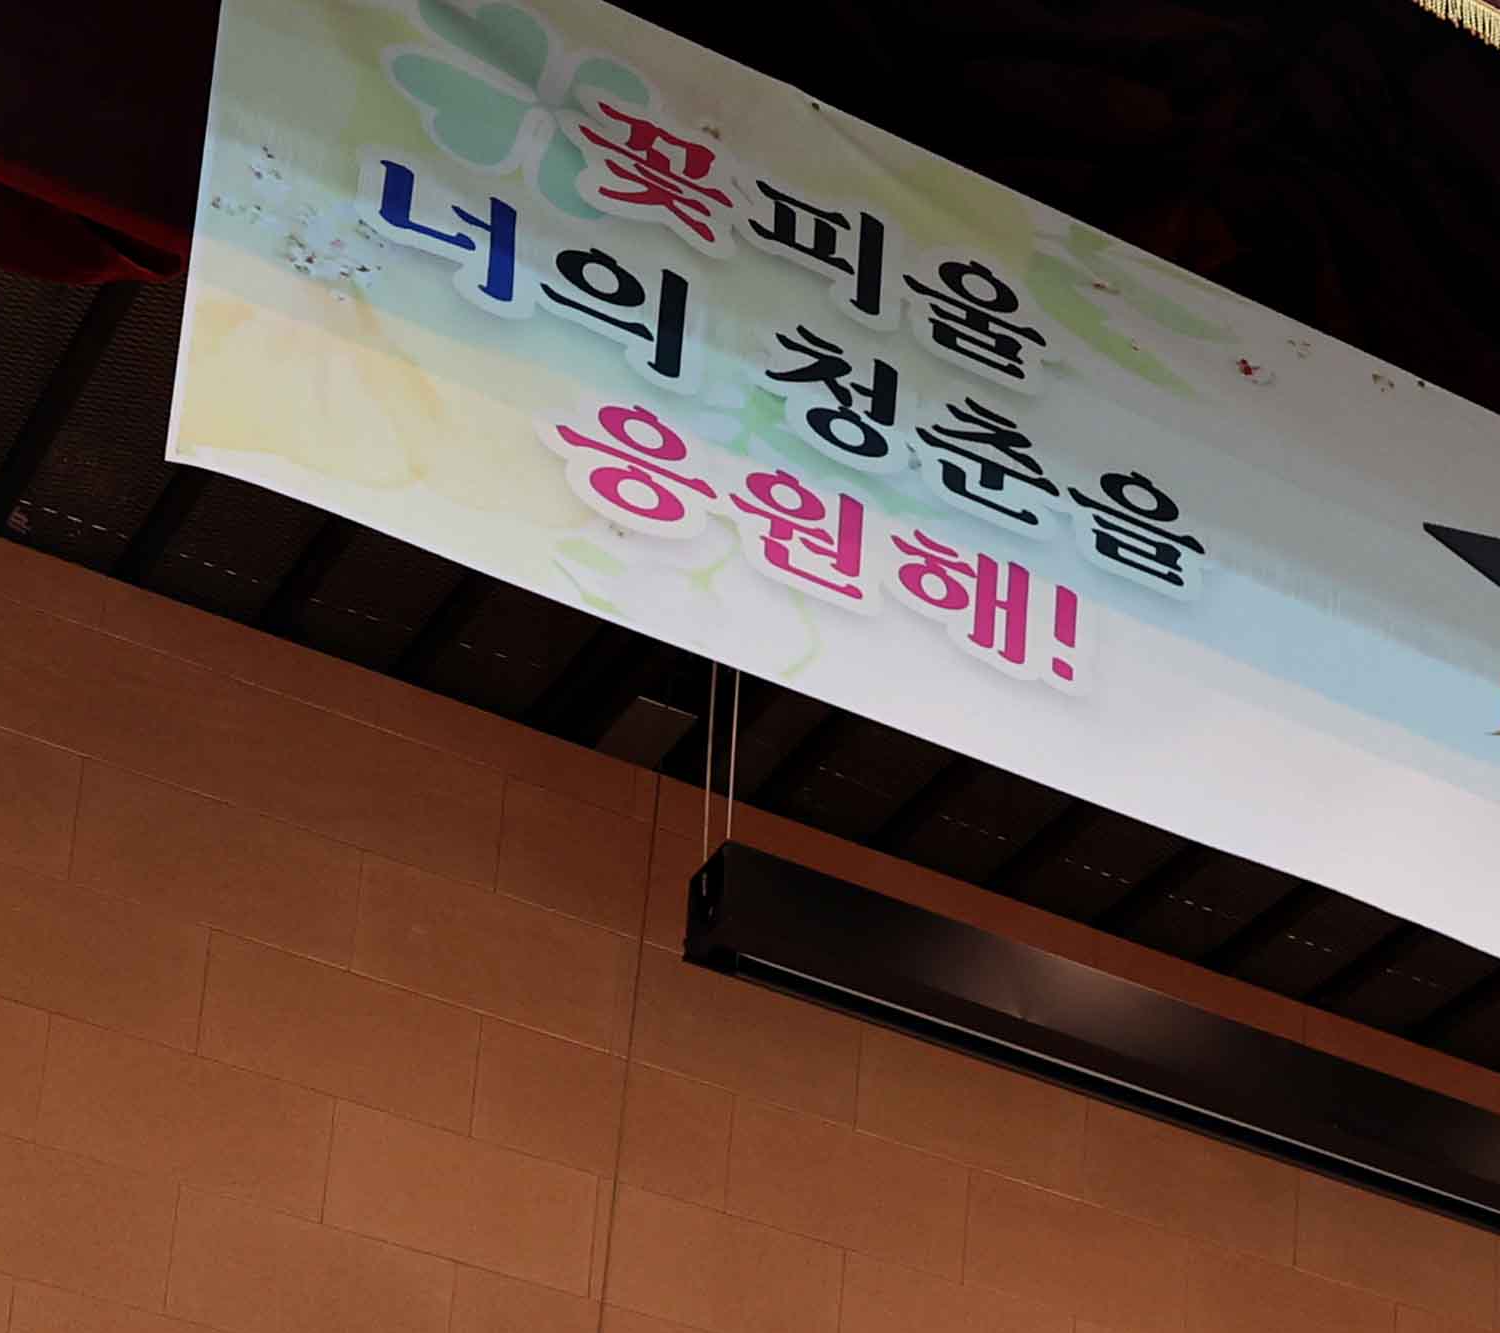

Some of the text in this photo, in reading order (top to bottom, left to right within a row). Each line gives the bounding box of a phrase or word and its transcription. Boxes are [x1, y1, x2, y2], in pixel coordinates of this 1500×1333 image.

[379, 159, 1205, 588] 너의 청춘을
[578, 101, 1047, 380] 꽃피울
[558, 405, 1078, 682] 응원해!
